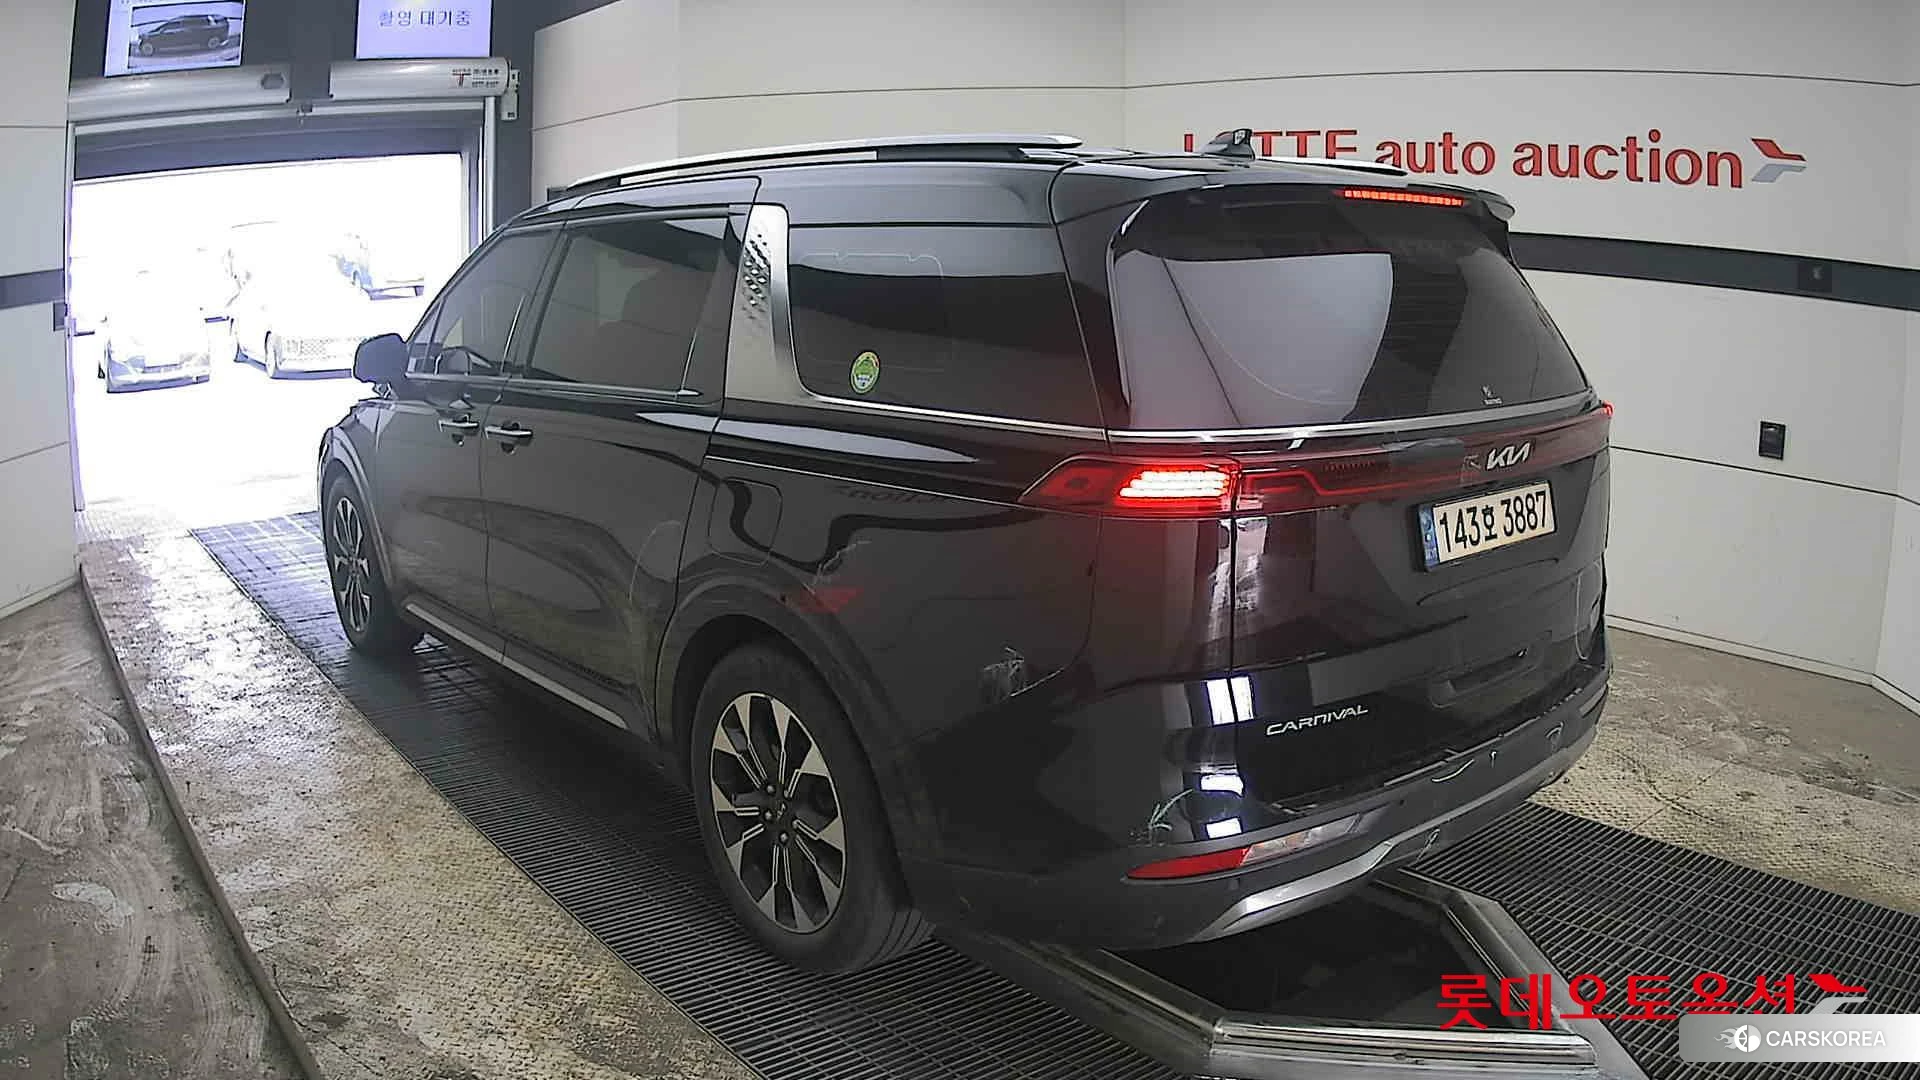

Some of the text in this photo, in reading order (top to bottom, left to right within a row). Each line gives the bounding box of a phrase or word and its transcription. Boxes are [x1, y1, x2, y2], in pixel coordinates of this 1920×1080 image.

[420, 9, 471, 26] 대기중
[1375, 131, 1496, 175] auto
[1512, 129, 1743, 188] auction
[1439, 490, 1547, 553] 143호 3887
[1266, 704, 1369, 736] CARNIVAL
